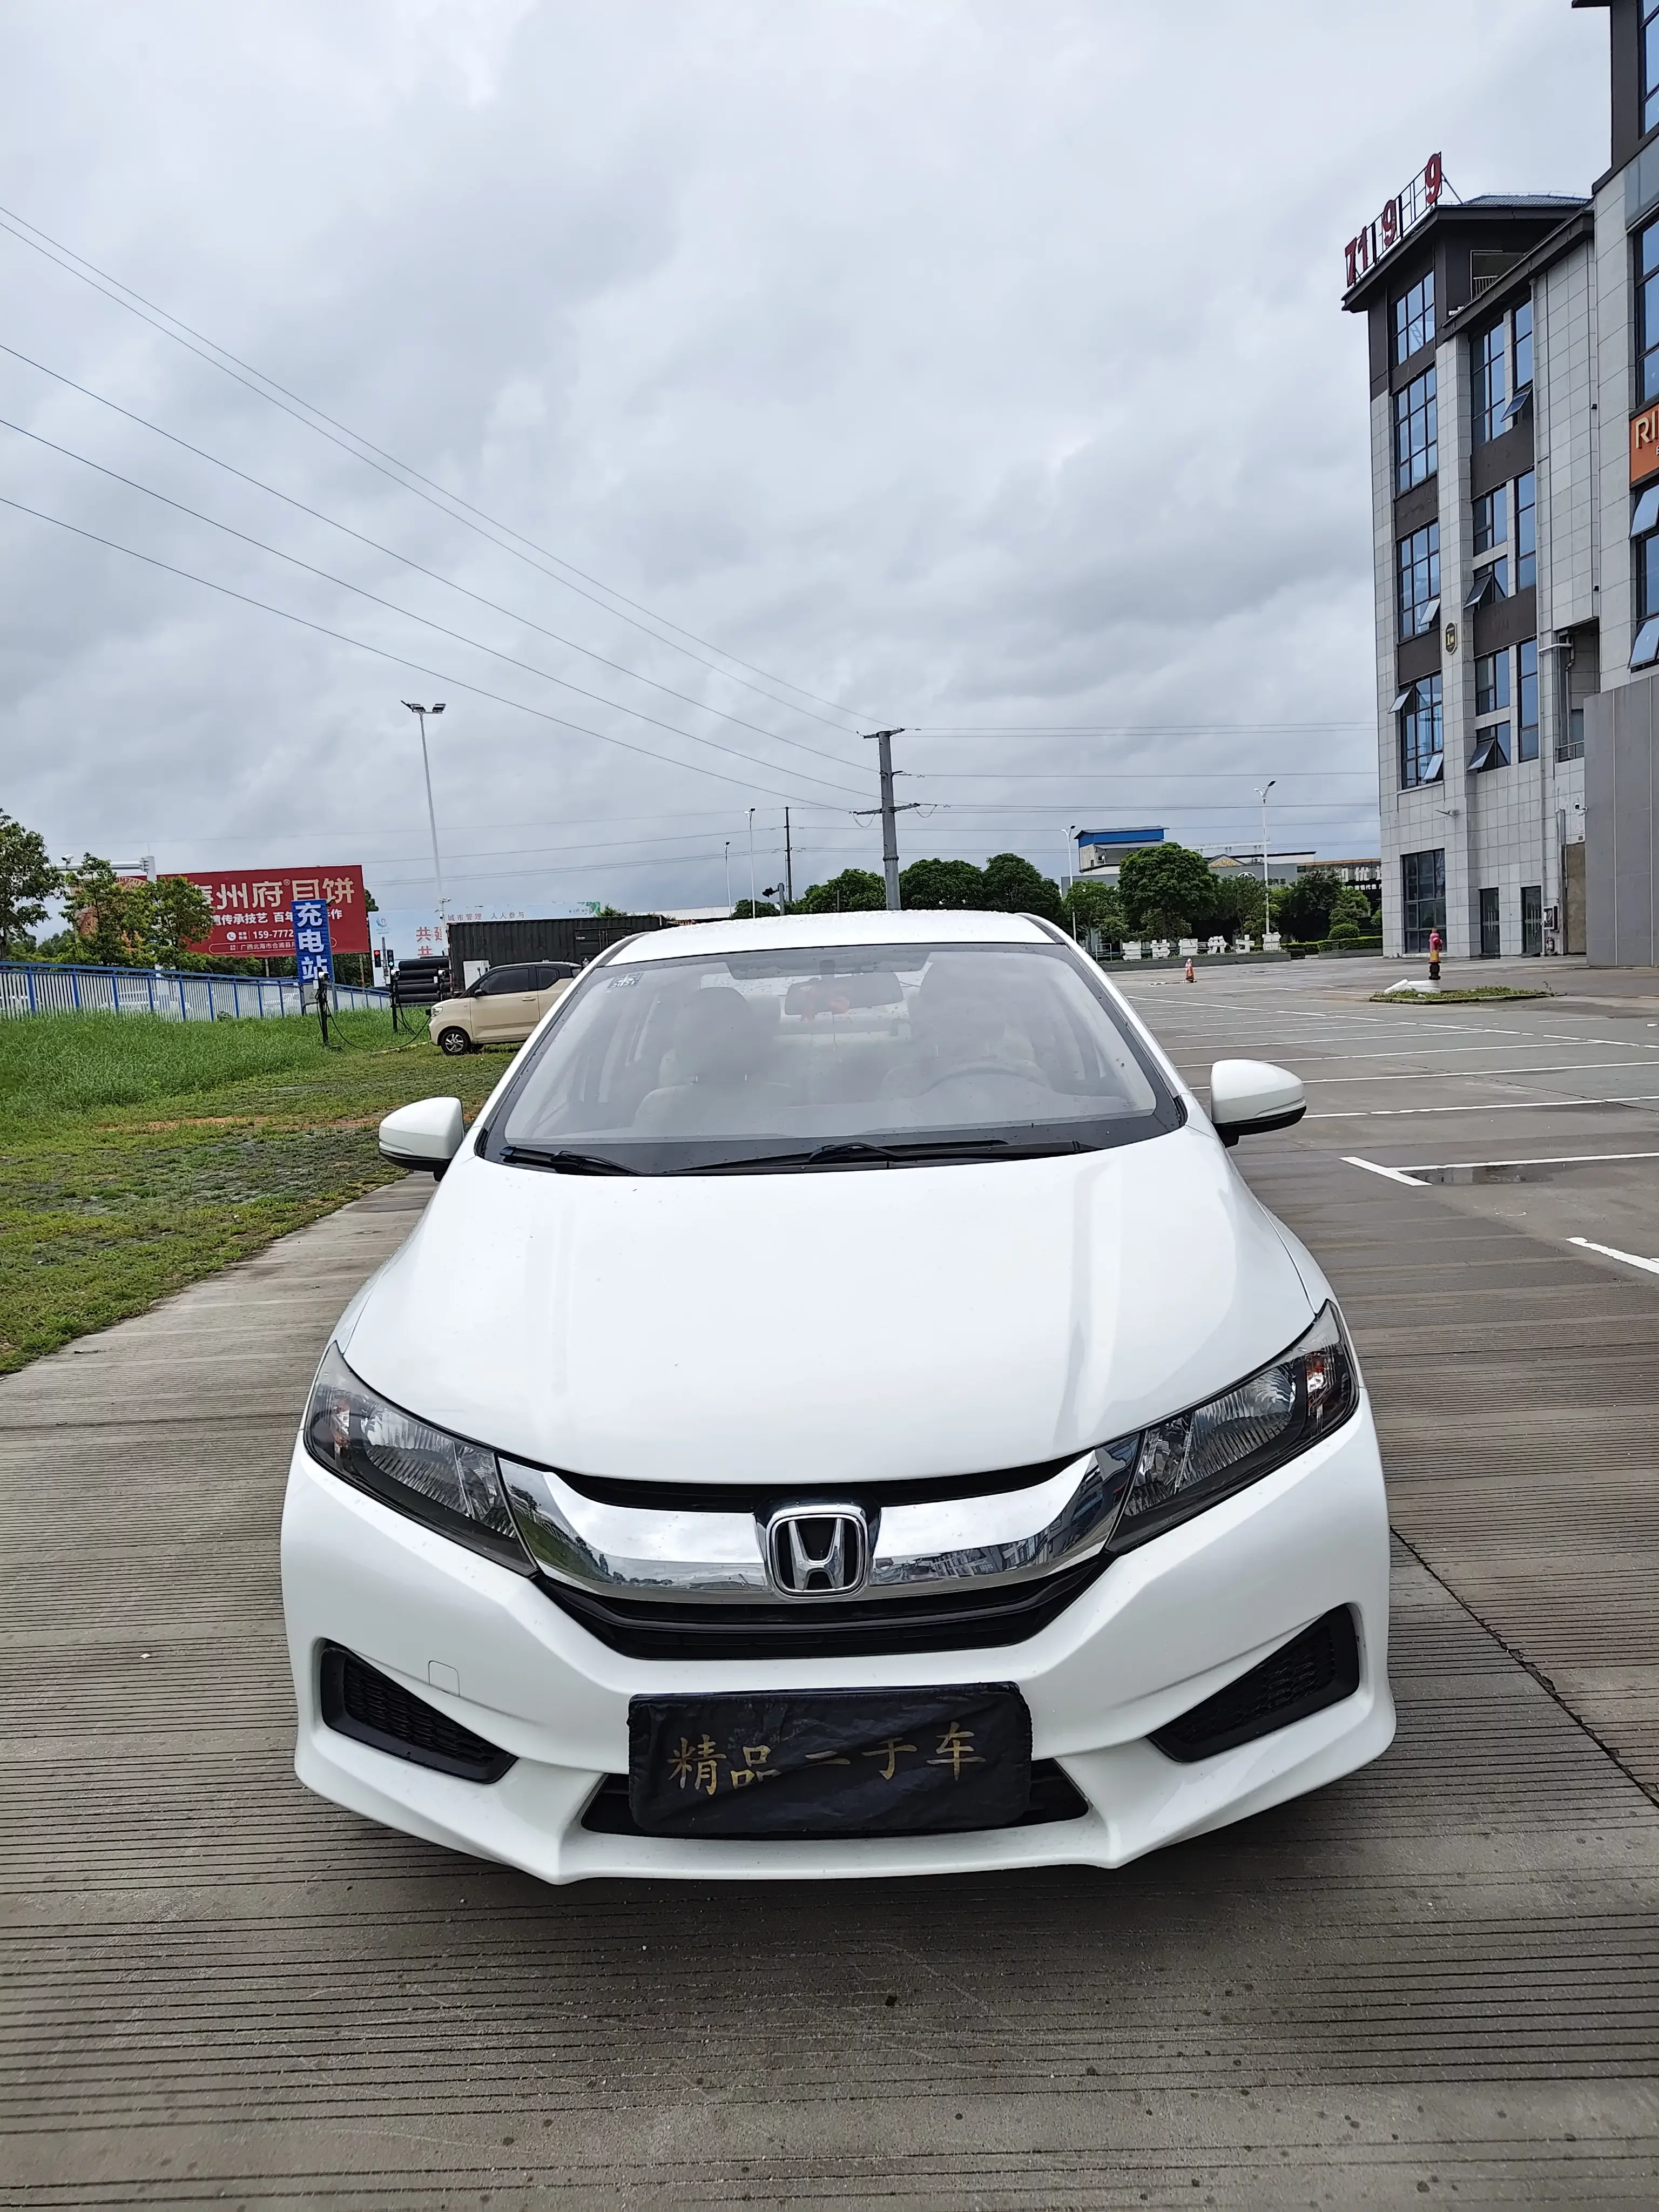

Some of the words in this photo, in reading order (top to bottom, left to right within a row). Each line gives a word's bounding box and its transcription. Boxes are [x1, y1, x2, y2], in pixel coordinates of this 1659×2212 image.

[1635, 409, 1659, 449] RI
[448, 913, 482, 921] 城市管理
[491, 911, 524, 919] 人人参与
[295, 902, 329, 980] 充电站
